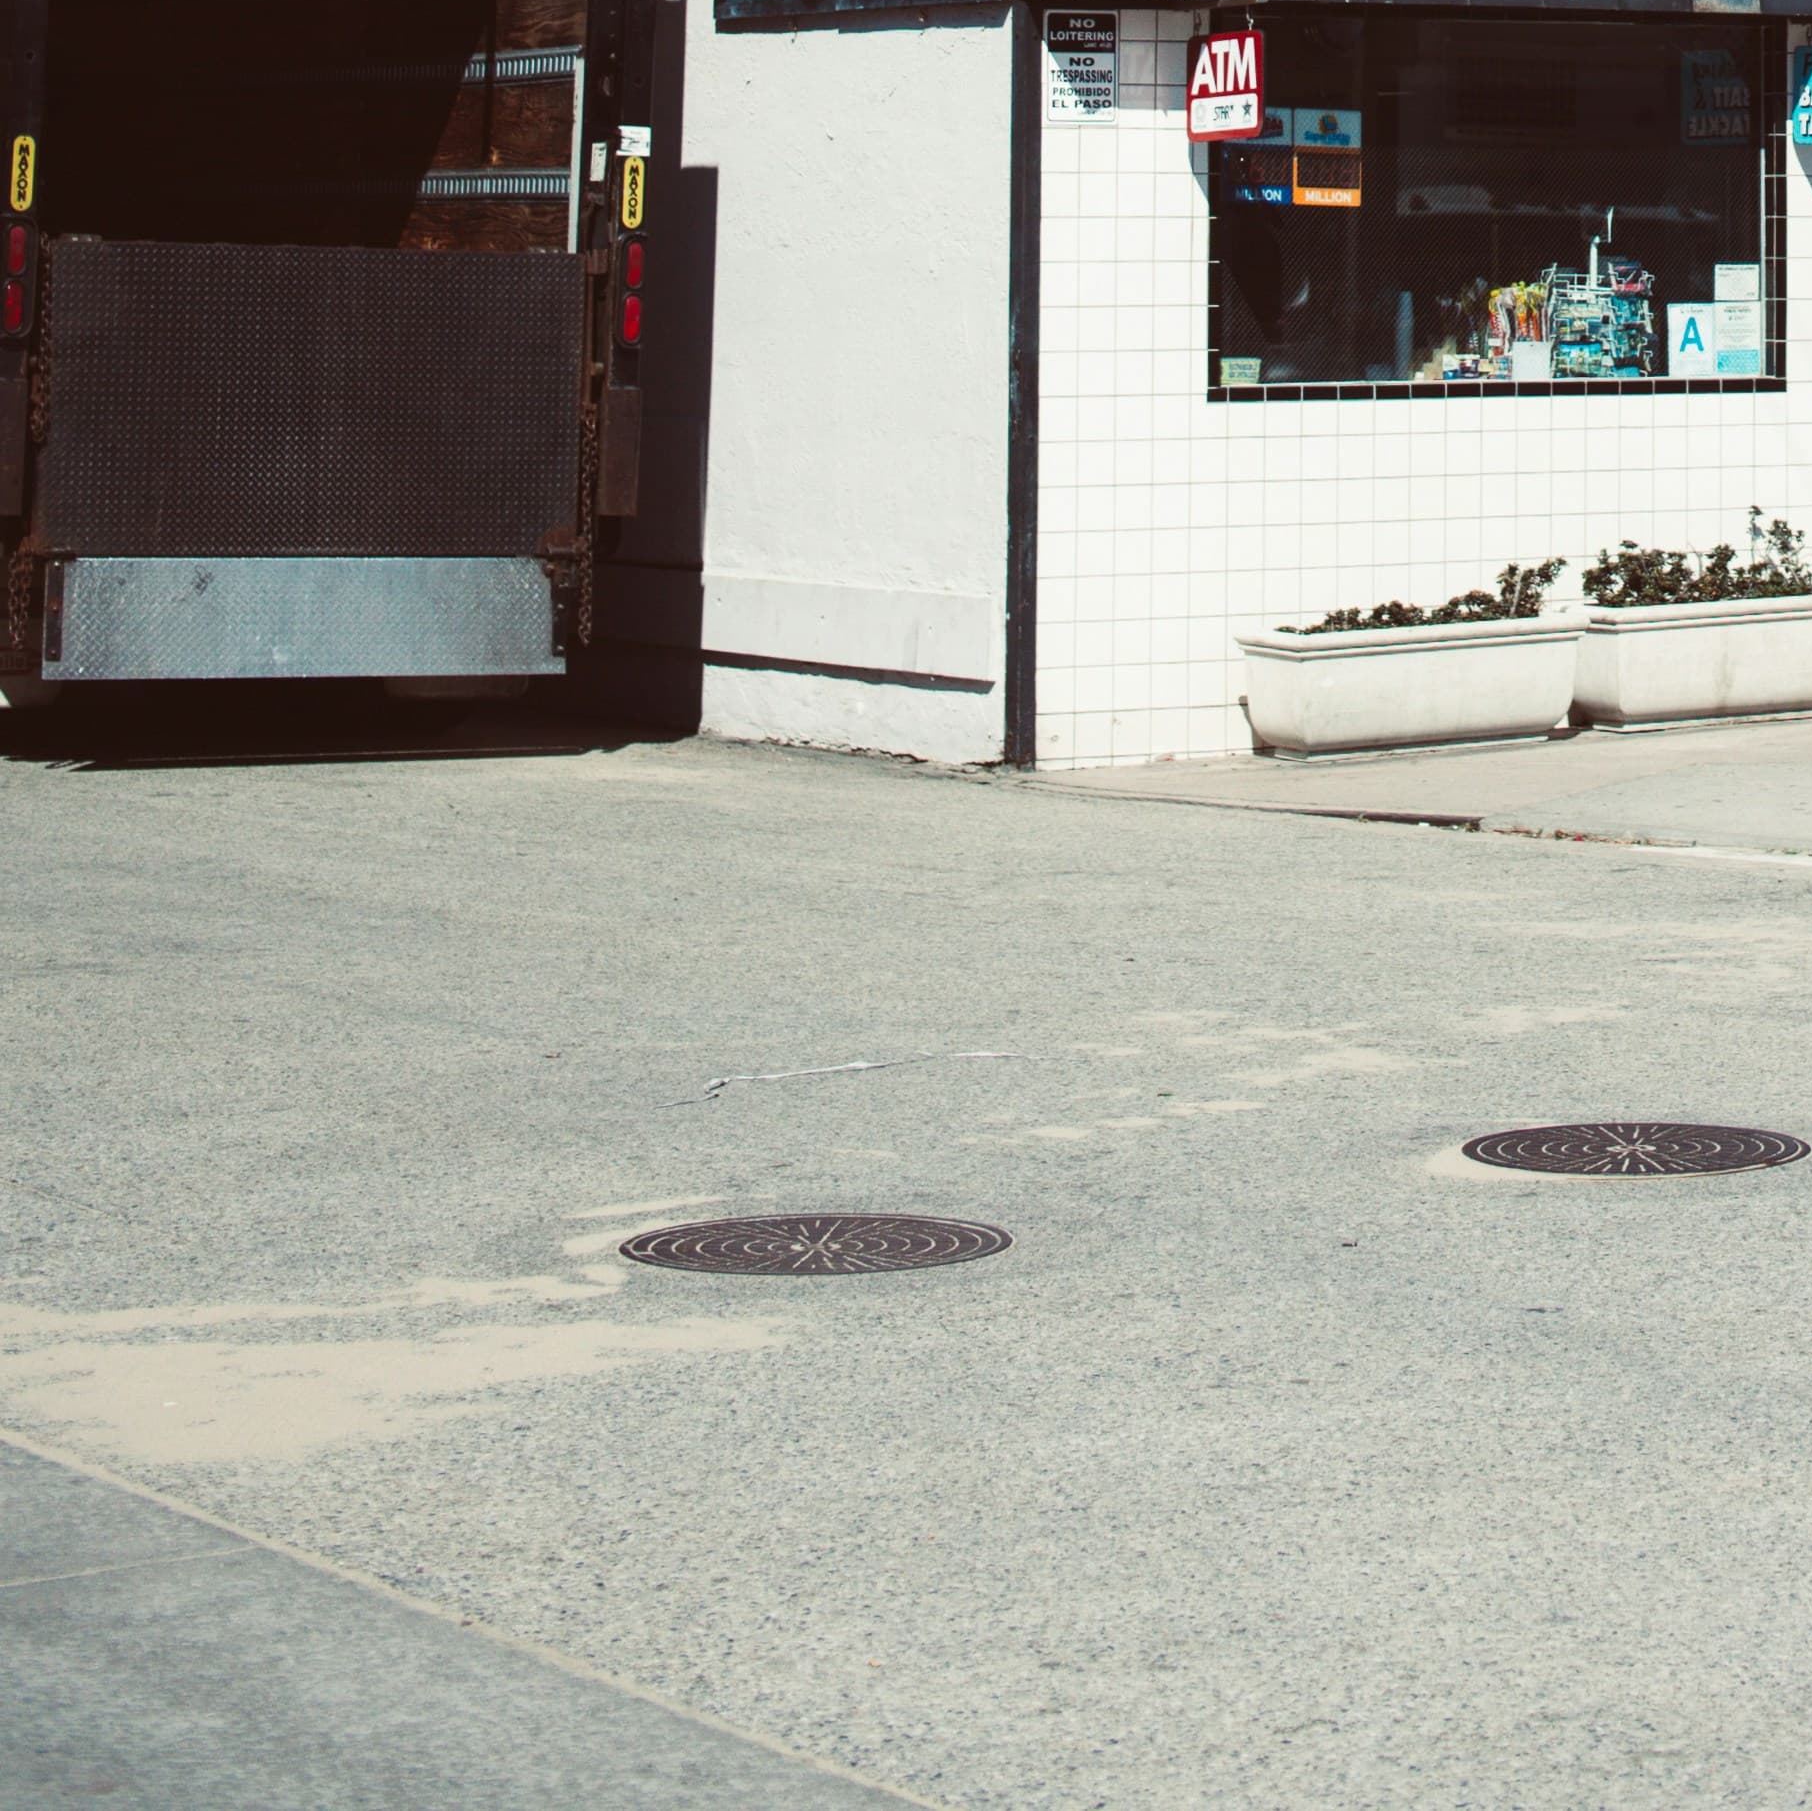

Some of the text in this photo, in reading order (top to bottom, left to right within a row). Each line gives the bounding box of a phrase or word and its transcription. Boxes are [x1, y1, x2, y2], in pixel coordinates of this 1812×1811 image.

[1069, 18, 1096, 28] NO
[1050, 31, 1114, 41] LOITERING
[1069, 57, 1095, 67] NO
[1191, 37, 1258, 96] ATM
[1051, 69, 1113, 84] TRESPASSING
[1053, 87, 1112, 96] PROHIBIDO
[1052, 99, 1112, 109] EL PASO
[17, 144, 30, 202] MAXON
[629, 165, 639, 219] MAXON
[1305, 189, 1352, 203] MILLION
[1679, 316, 1705, 353] A
